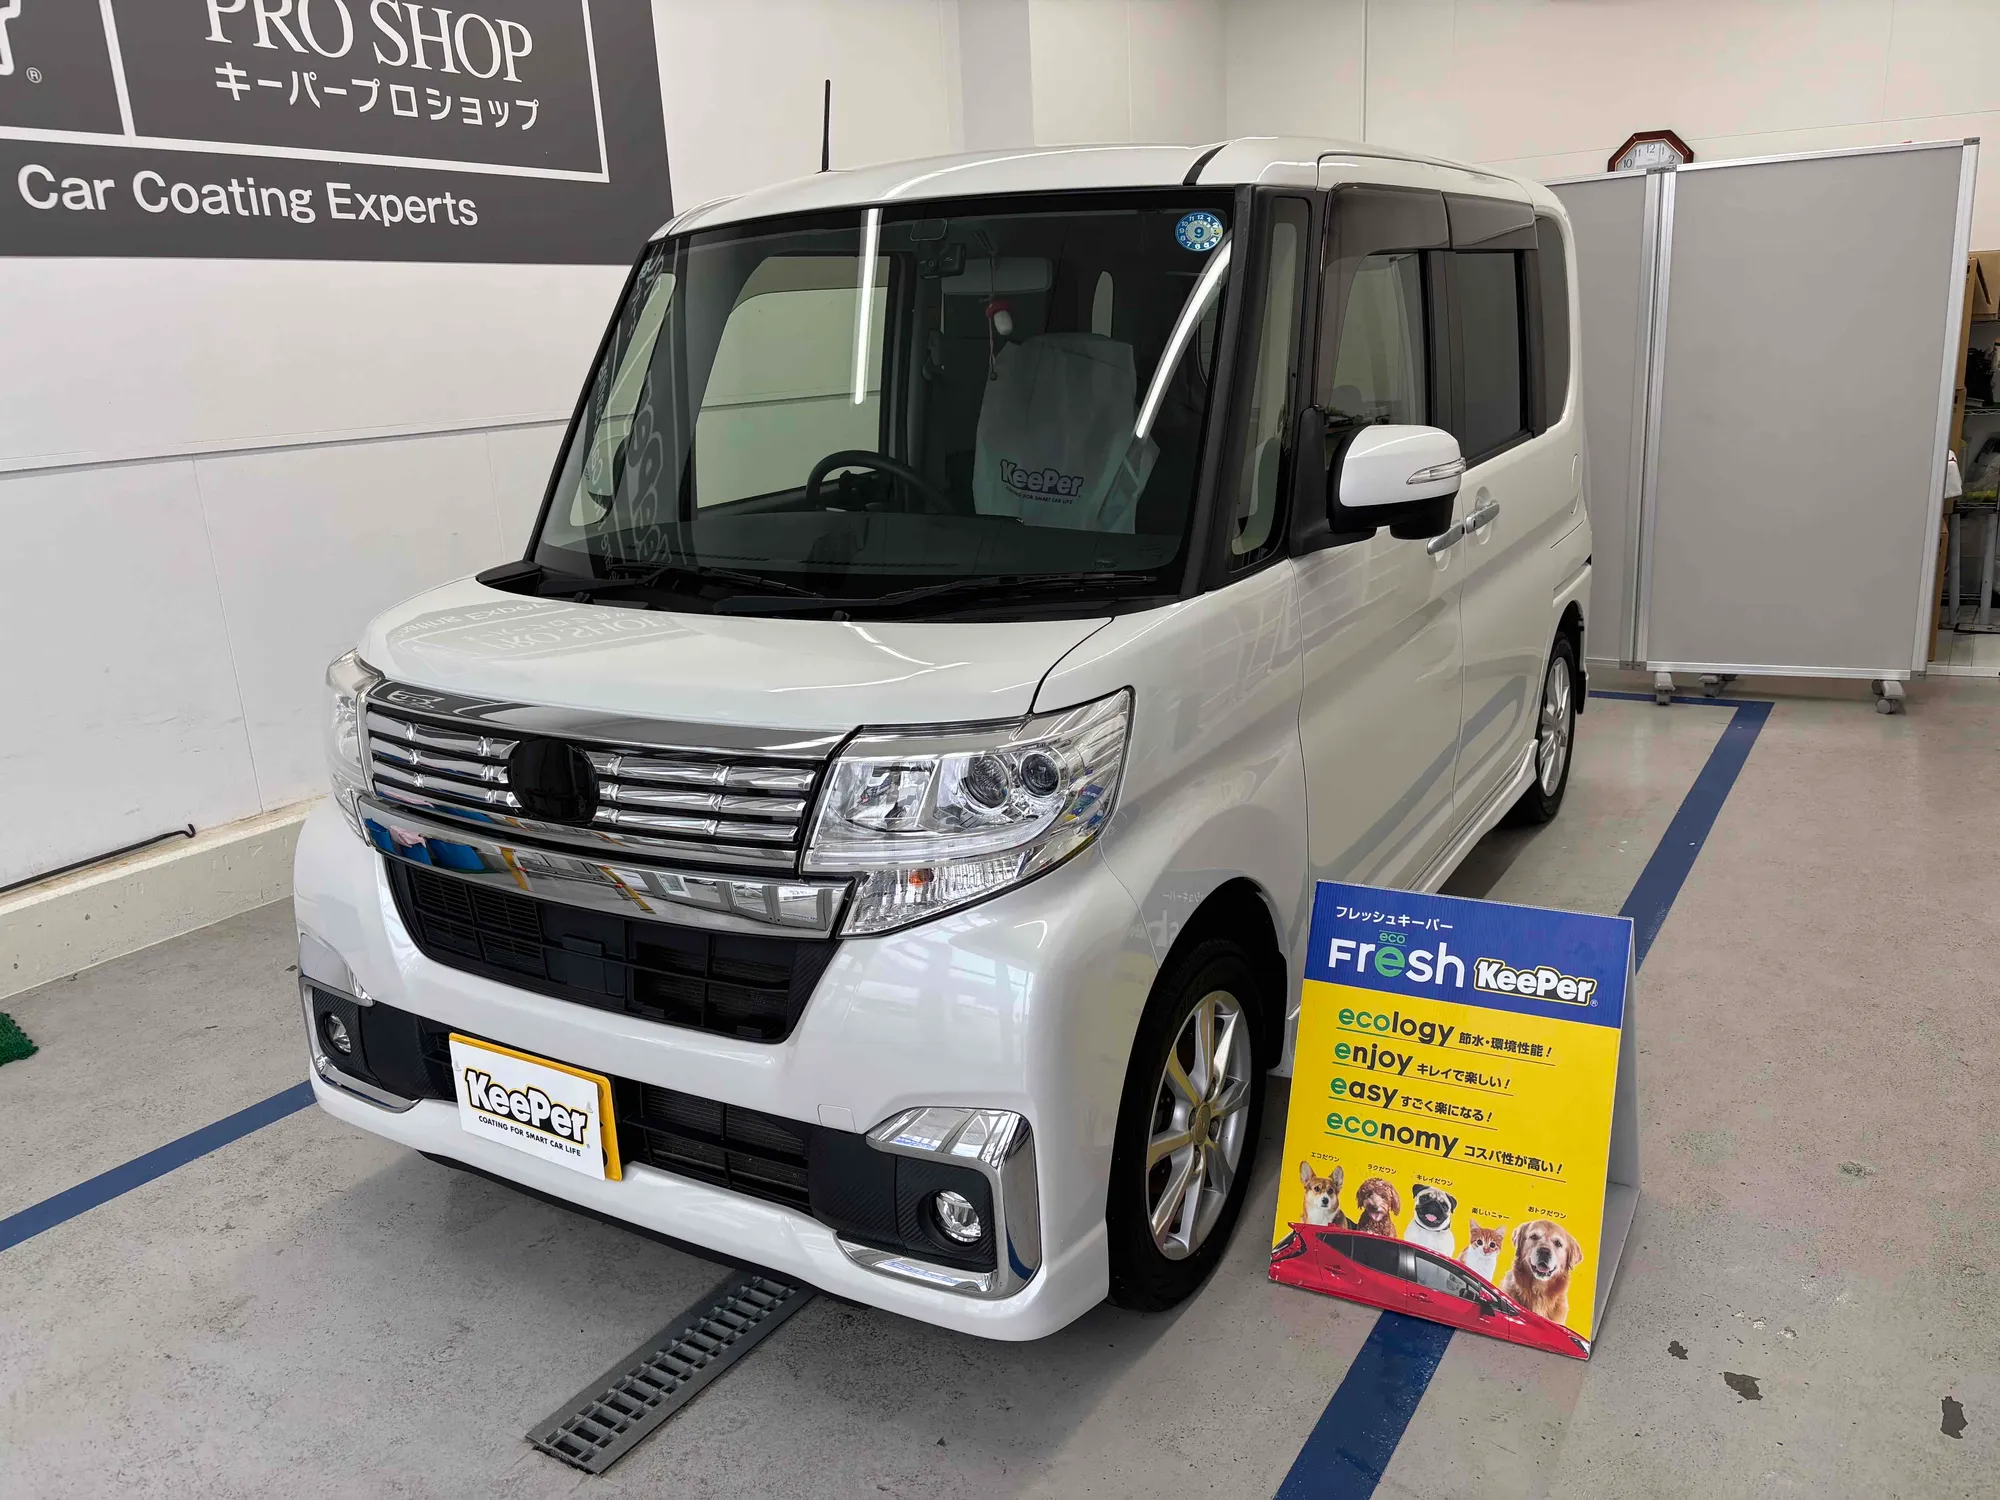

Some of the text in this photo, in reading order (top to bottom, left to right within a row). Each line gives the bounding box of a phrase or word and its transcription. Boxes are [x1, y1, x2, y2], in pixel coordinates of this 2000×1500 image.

[204, 0, 533, 83] PRO SHOP
[215, 61, 540, 131] キーパープロショップ
[1623, 159, 1632, 168] 10
[1646, 144, 1655, 153] 12
[17, 164, 479, 227] Car Coating Experts
[1194, 226, 1204, 239] 9
[1000, 458, 1084, 497] KeePer
[1336, 906, 1454, 931] フレッシュキーパー
[1379, 932, 1406, 944] eco
[1328, 938, 1598, 1007] Fresh KeePer
[1338, 1008, 1455, 1047] ecology
[1334, 1042, 1413, 1076] enjoy
[465, 1067, 589, 1145] KeePer
[1330, 1077, 1398, 1109] easy
[479, 1115, 581, 1157] COATING FOR SMART CAR LIFE
[1326, 1112, 1459, 1158] economy
[1311, 1151, 1340, 1163] エコだワン
[1367, 1163, 1397, 1175] ラクだワン
[1416, 1174, 1453, 1187] キレイだワン
[1471, 1207, 1510, 1220] 楽しいニャー
[1528, 1206, 1567, 1219] おトクだワン
